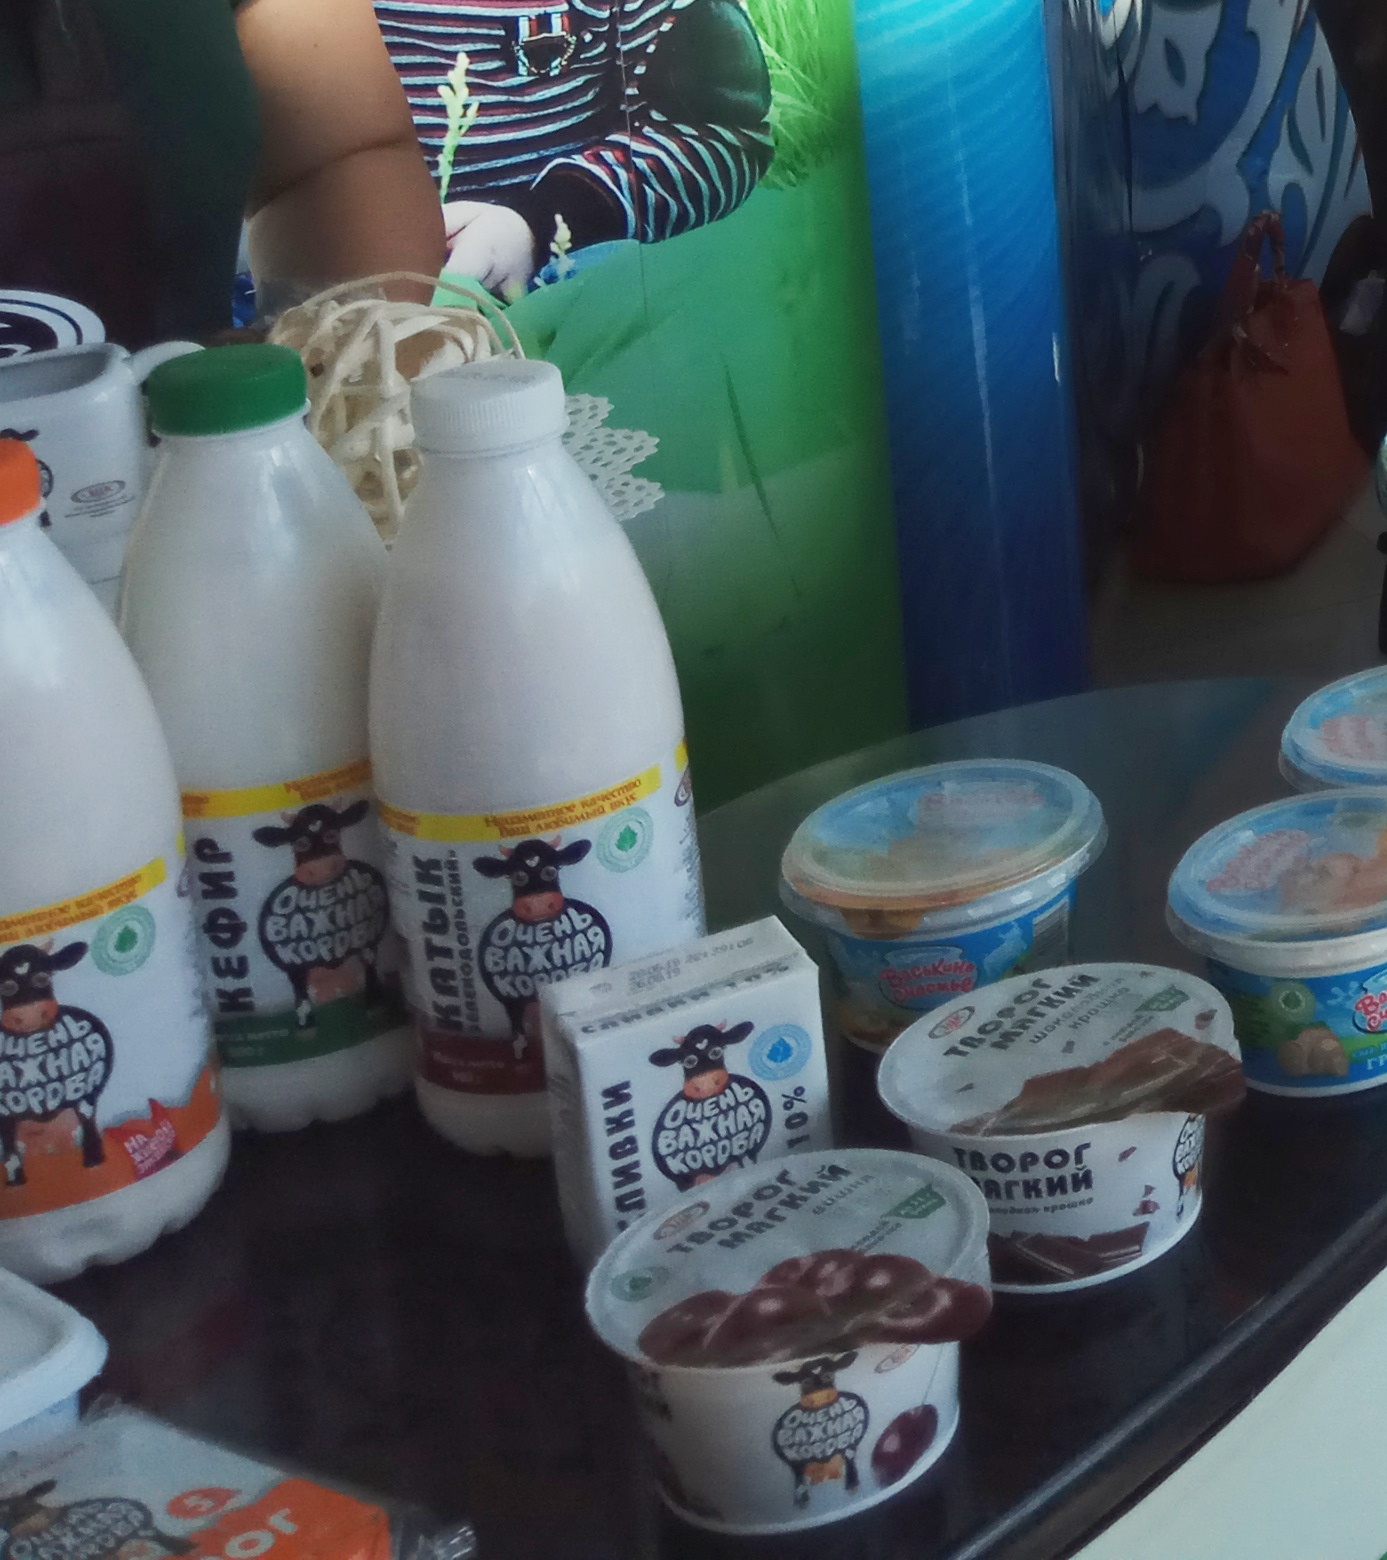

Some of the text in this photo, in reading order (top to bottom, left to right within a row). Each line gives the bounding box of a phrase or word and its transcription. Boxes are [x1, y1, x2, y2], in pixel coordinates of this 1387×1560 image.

[272, 866, 372, 915] ОЧЕНЬ
[193, 837, 255, 1013] КЕФИР
[411, 853, 464, 1032] КАТЫК
[484, 925, 606, 973] ВАЖНАЯ
[494, 907, 594, 947] ОЧЕНЬ
[0, 1014, 92, 1056] ЧЕНЬ
[943, 977, 1052, 1057] ТВОРОГ
[989, 973, 1099, 1051] МЯГКИЙ
[0, 1034, 106, 1089] АЖНАЯ
[658, 1098, 767, 1156] ВАЖНАЯ
[664, 1083, 755, 1130] ОЧЕНЬ
[781, 1085, 811, 1149] 10%
[601, 1080, 648, 1233] ЛИВКИ
[666, 1123, 766, 1175] КОРОВА
[954, 1142, 1092, 1174] ТВОРОГ
[666, 1168, 800, 1256] ТВОРОГ
[716, 1163, 853, 1250] МЯГКИЙ
